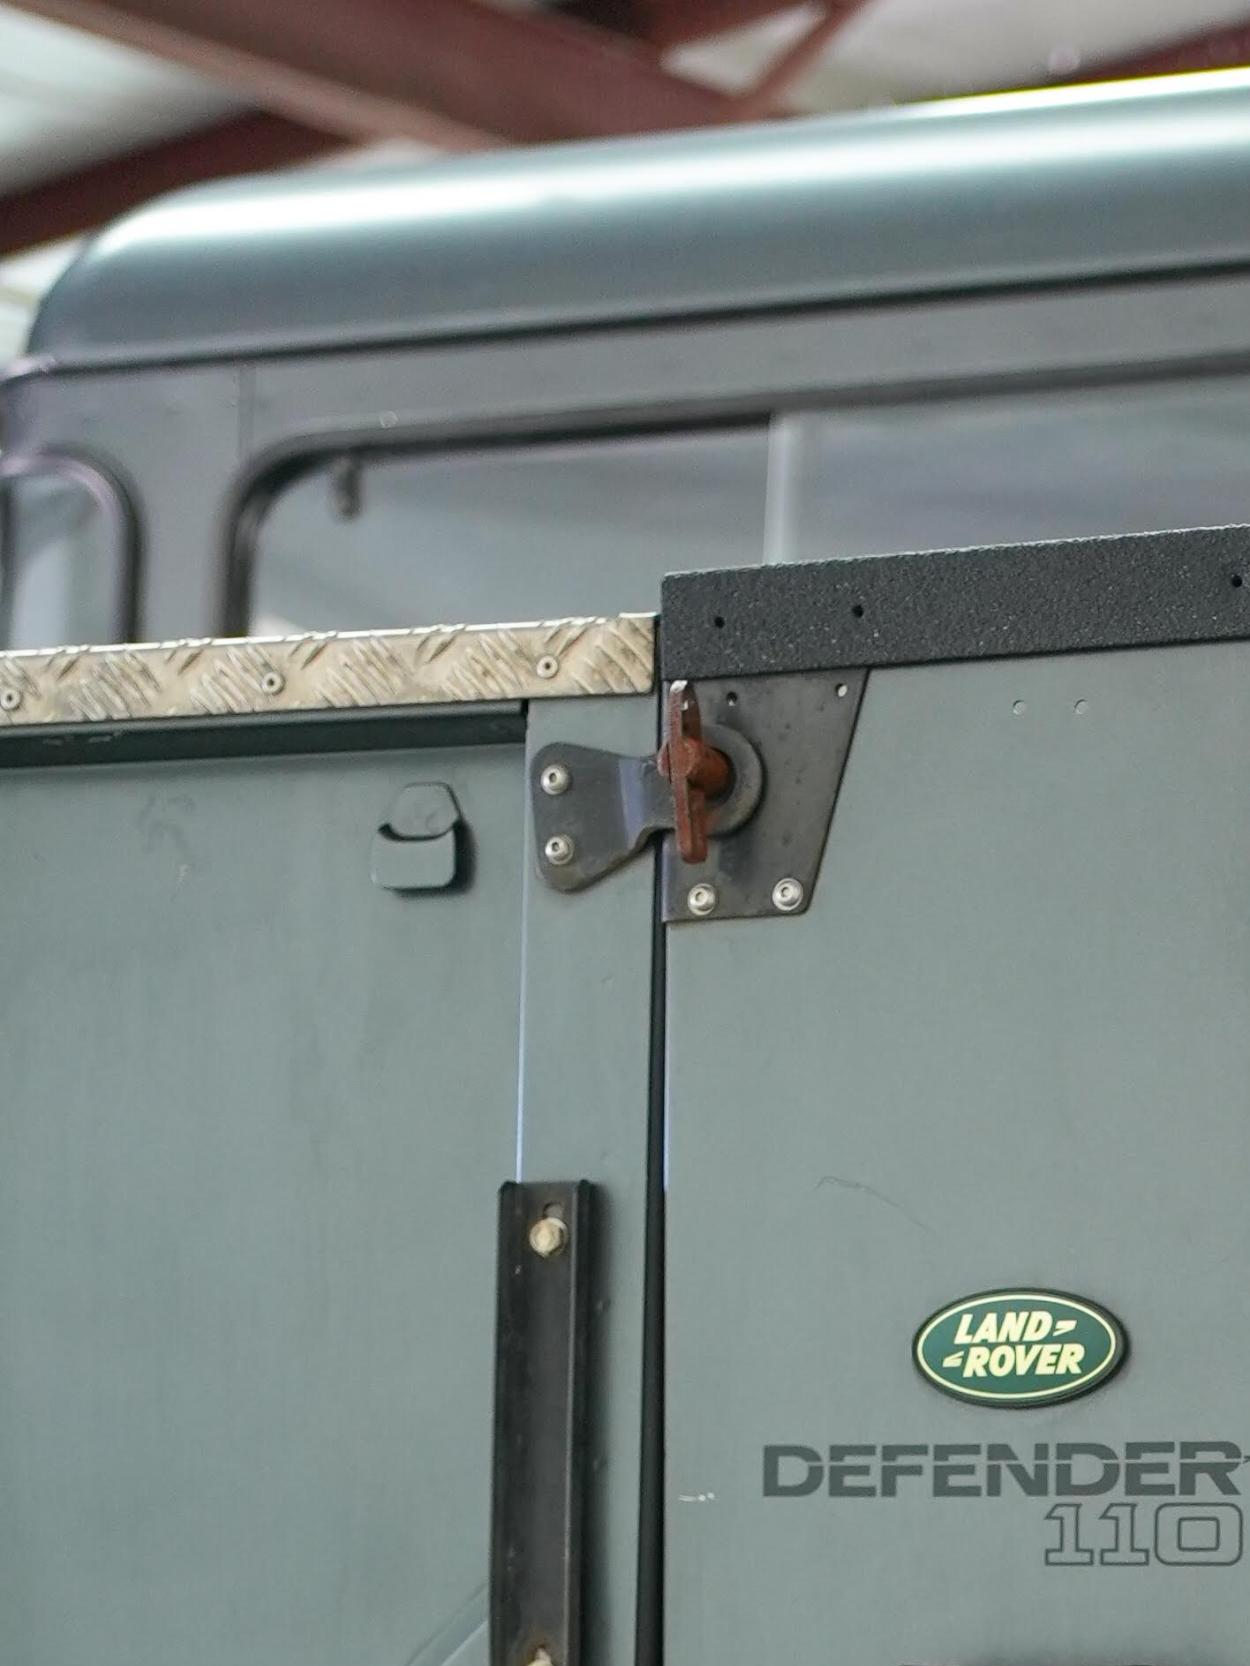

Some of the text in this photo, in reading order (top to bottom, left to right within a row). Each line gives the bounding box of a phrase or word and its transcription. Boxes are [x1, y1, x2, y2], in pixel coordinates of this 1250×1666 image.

[954, 1311, 1053, 1344] LAND
[963, 1343, 1085, 1378] ROVER
[763, 1441, 1242, 1497] DEFENDER
[1045, 1503, 1243, 1566] 110
